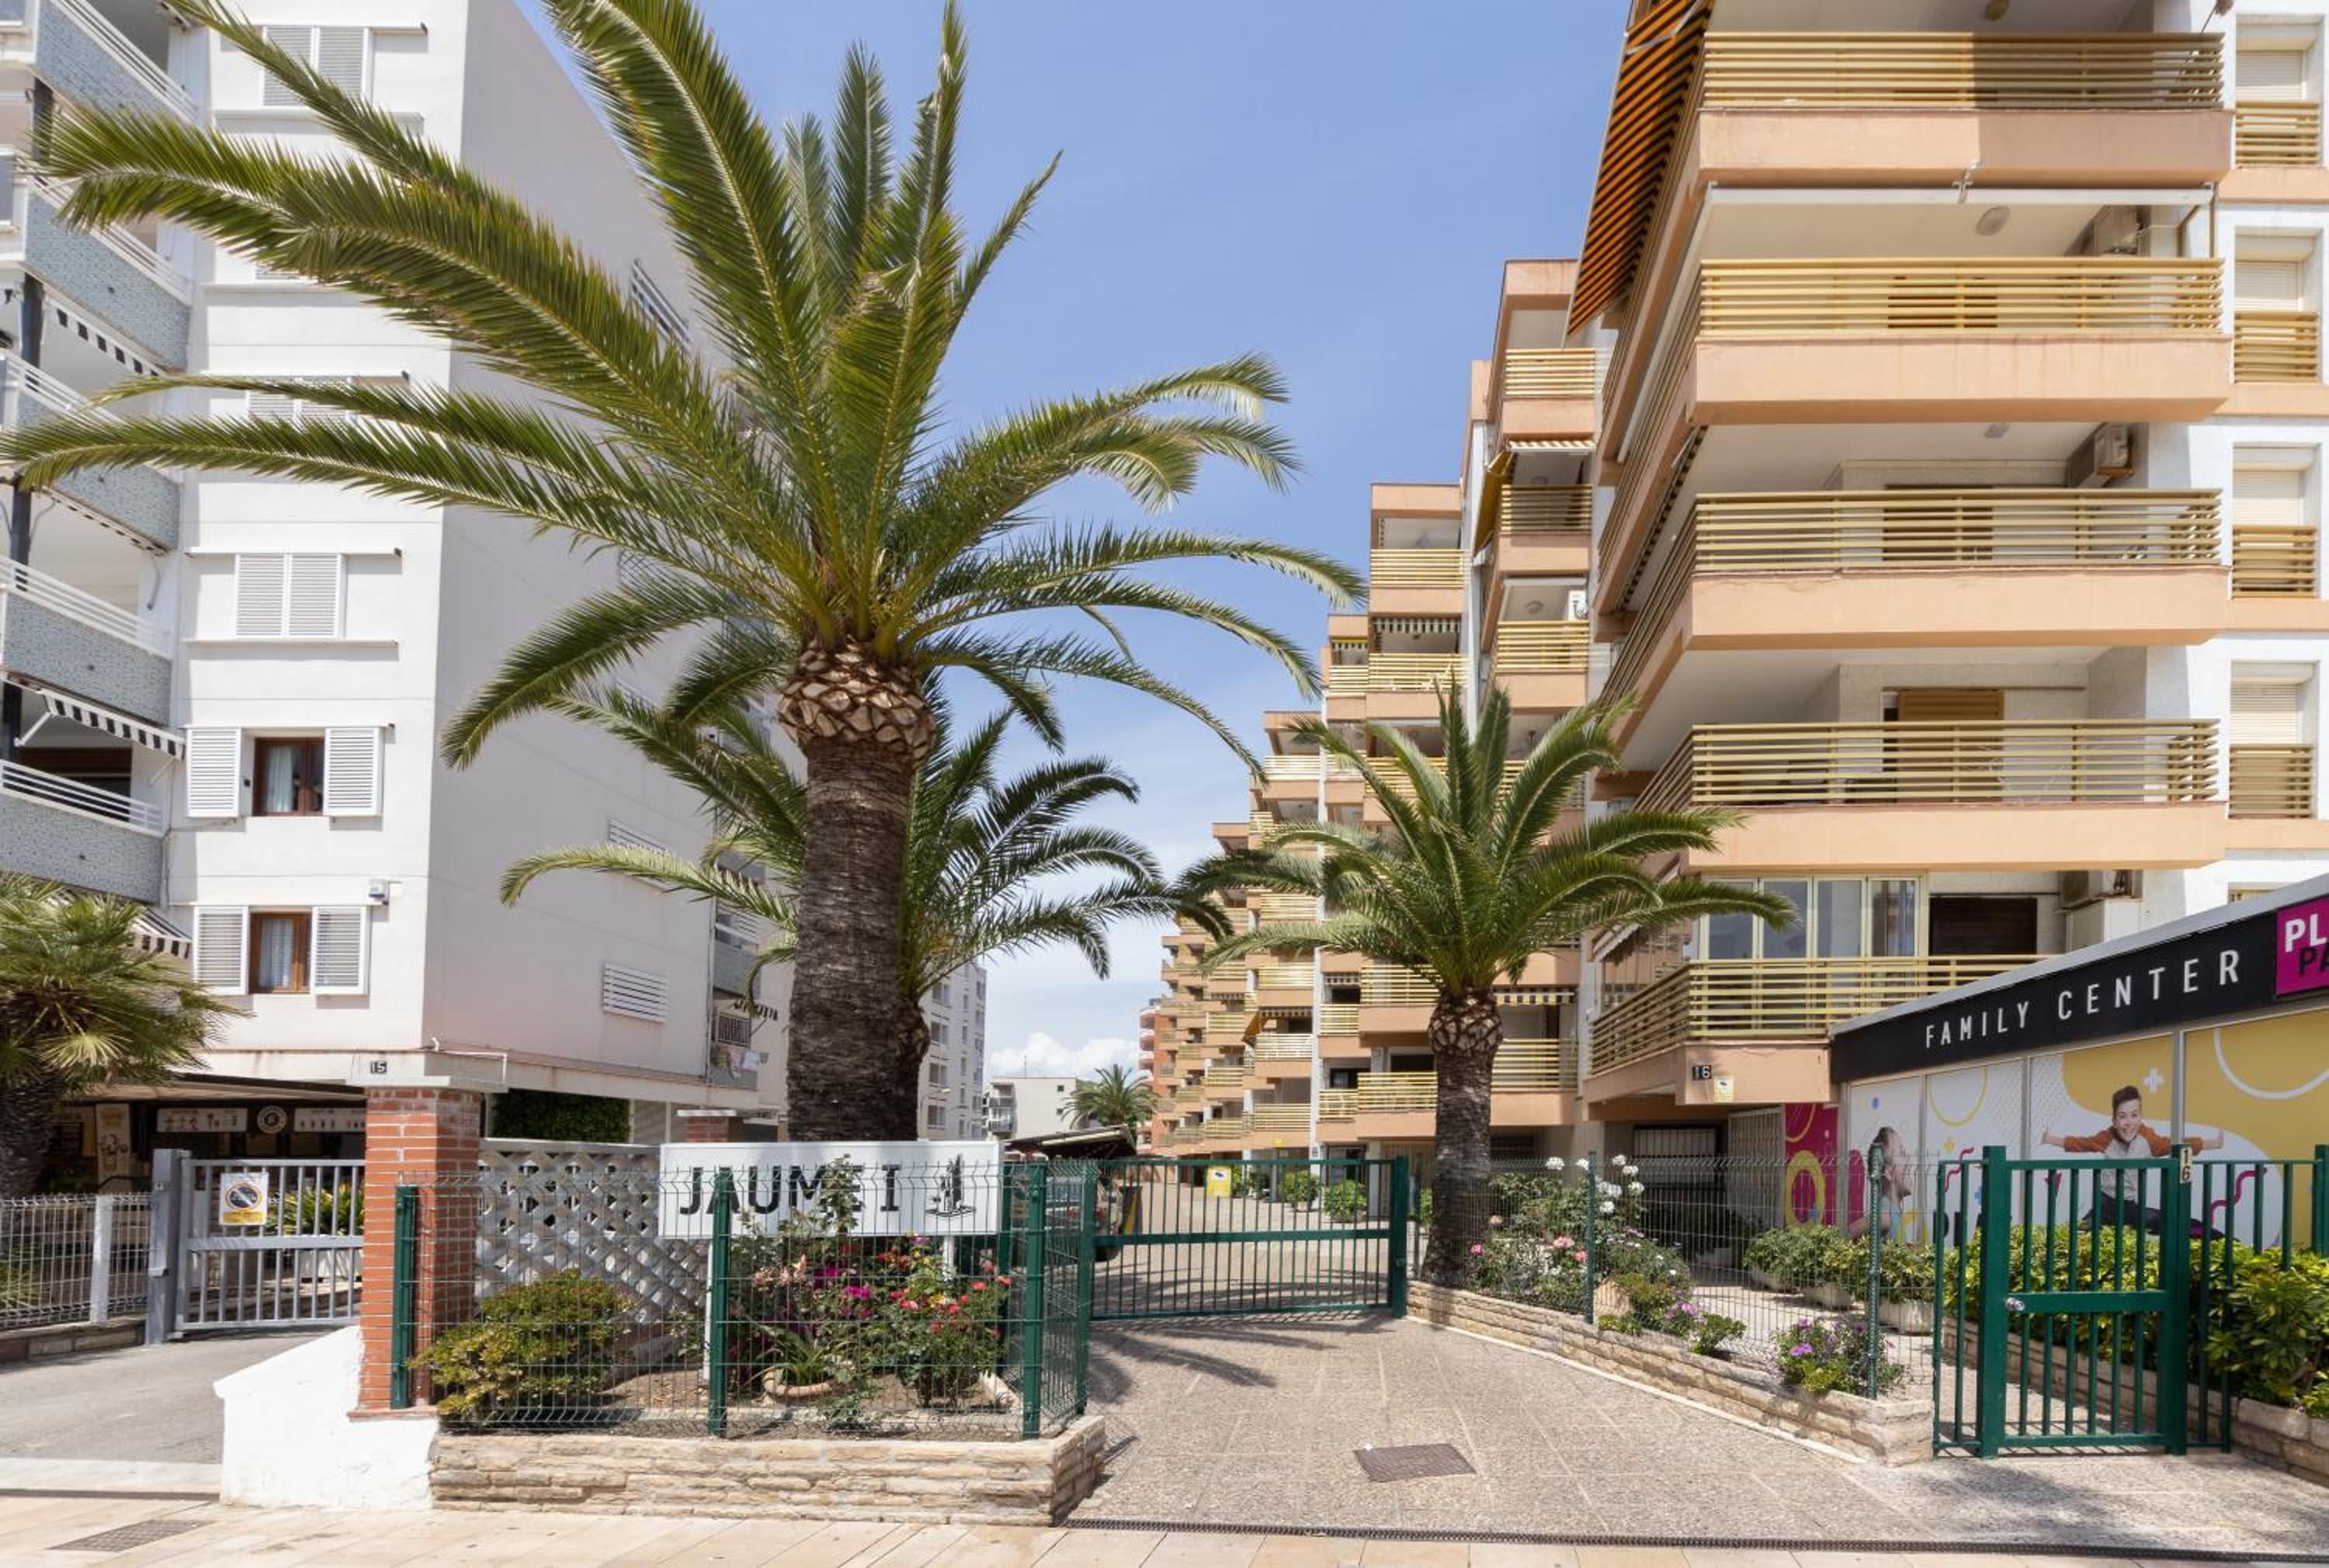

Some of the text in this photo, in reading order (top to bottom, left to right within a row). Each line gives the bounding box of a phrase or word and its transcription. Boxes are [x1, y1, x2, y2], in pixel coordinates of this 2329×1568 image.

[1925, 949, 2240, 1049] FAMILY CENTER
[1694, 1065, 1711, 1079] 16
[880, 1164, 901, 1212] I
